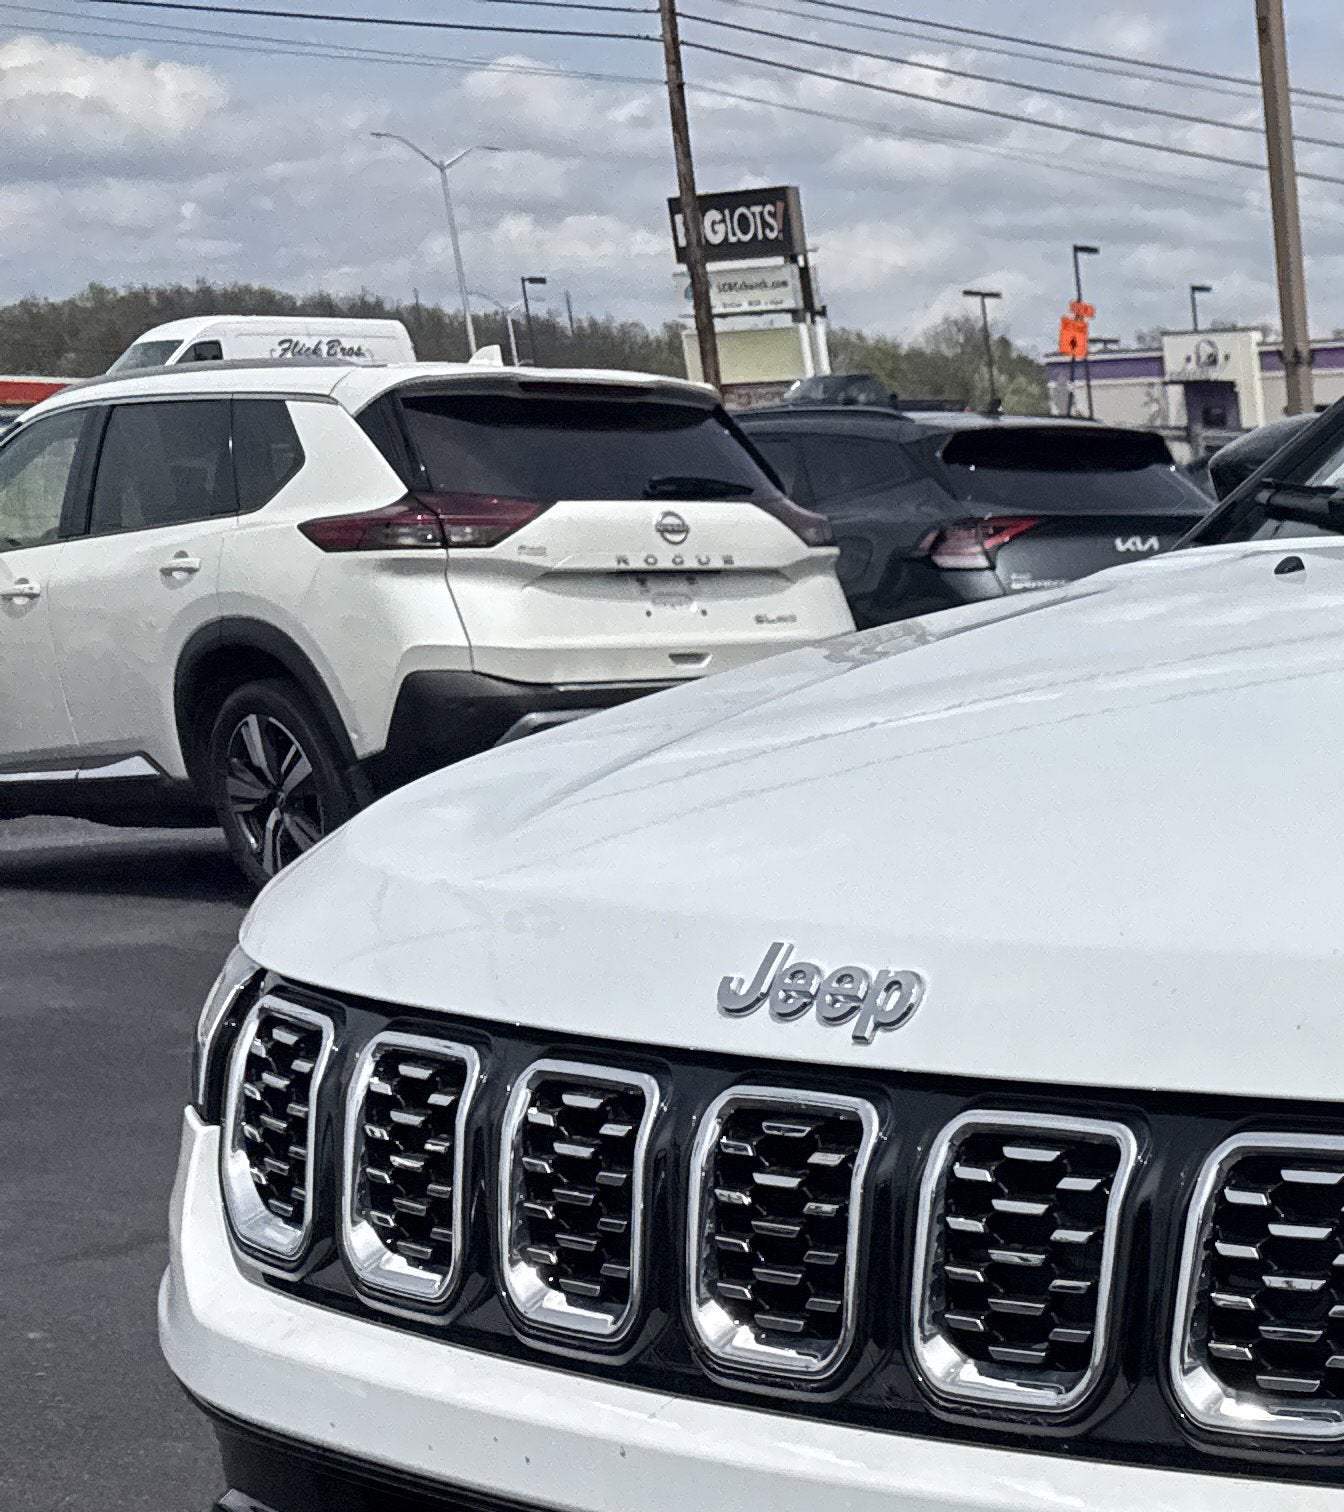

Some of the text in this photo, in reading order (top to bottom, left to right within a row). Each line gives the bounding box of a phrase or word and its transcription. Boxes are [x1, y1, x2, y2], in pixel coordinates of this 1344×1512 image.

[1115, 535, 1160, 552] KIA
[616, 553, 735, 567] ROGUE
[717, 941, 926, 1046] Jeep
